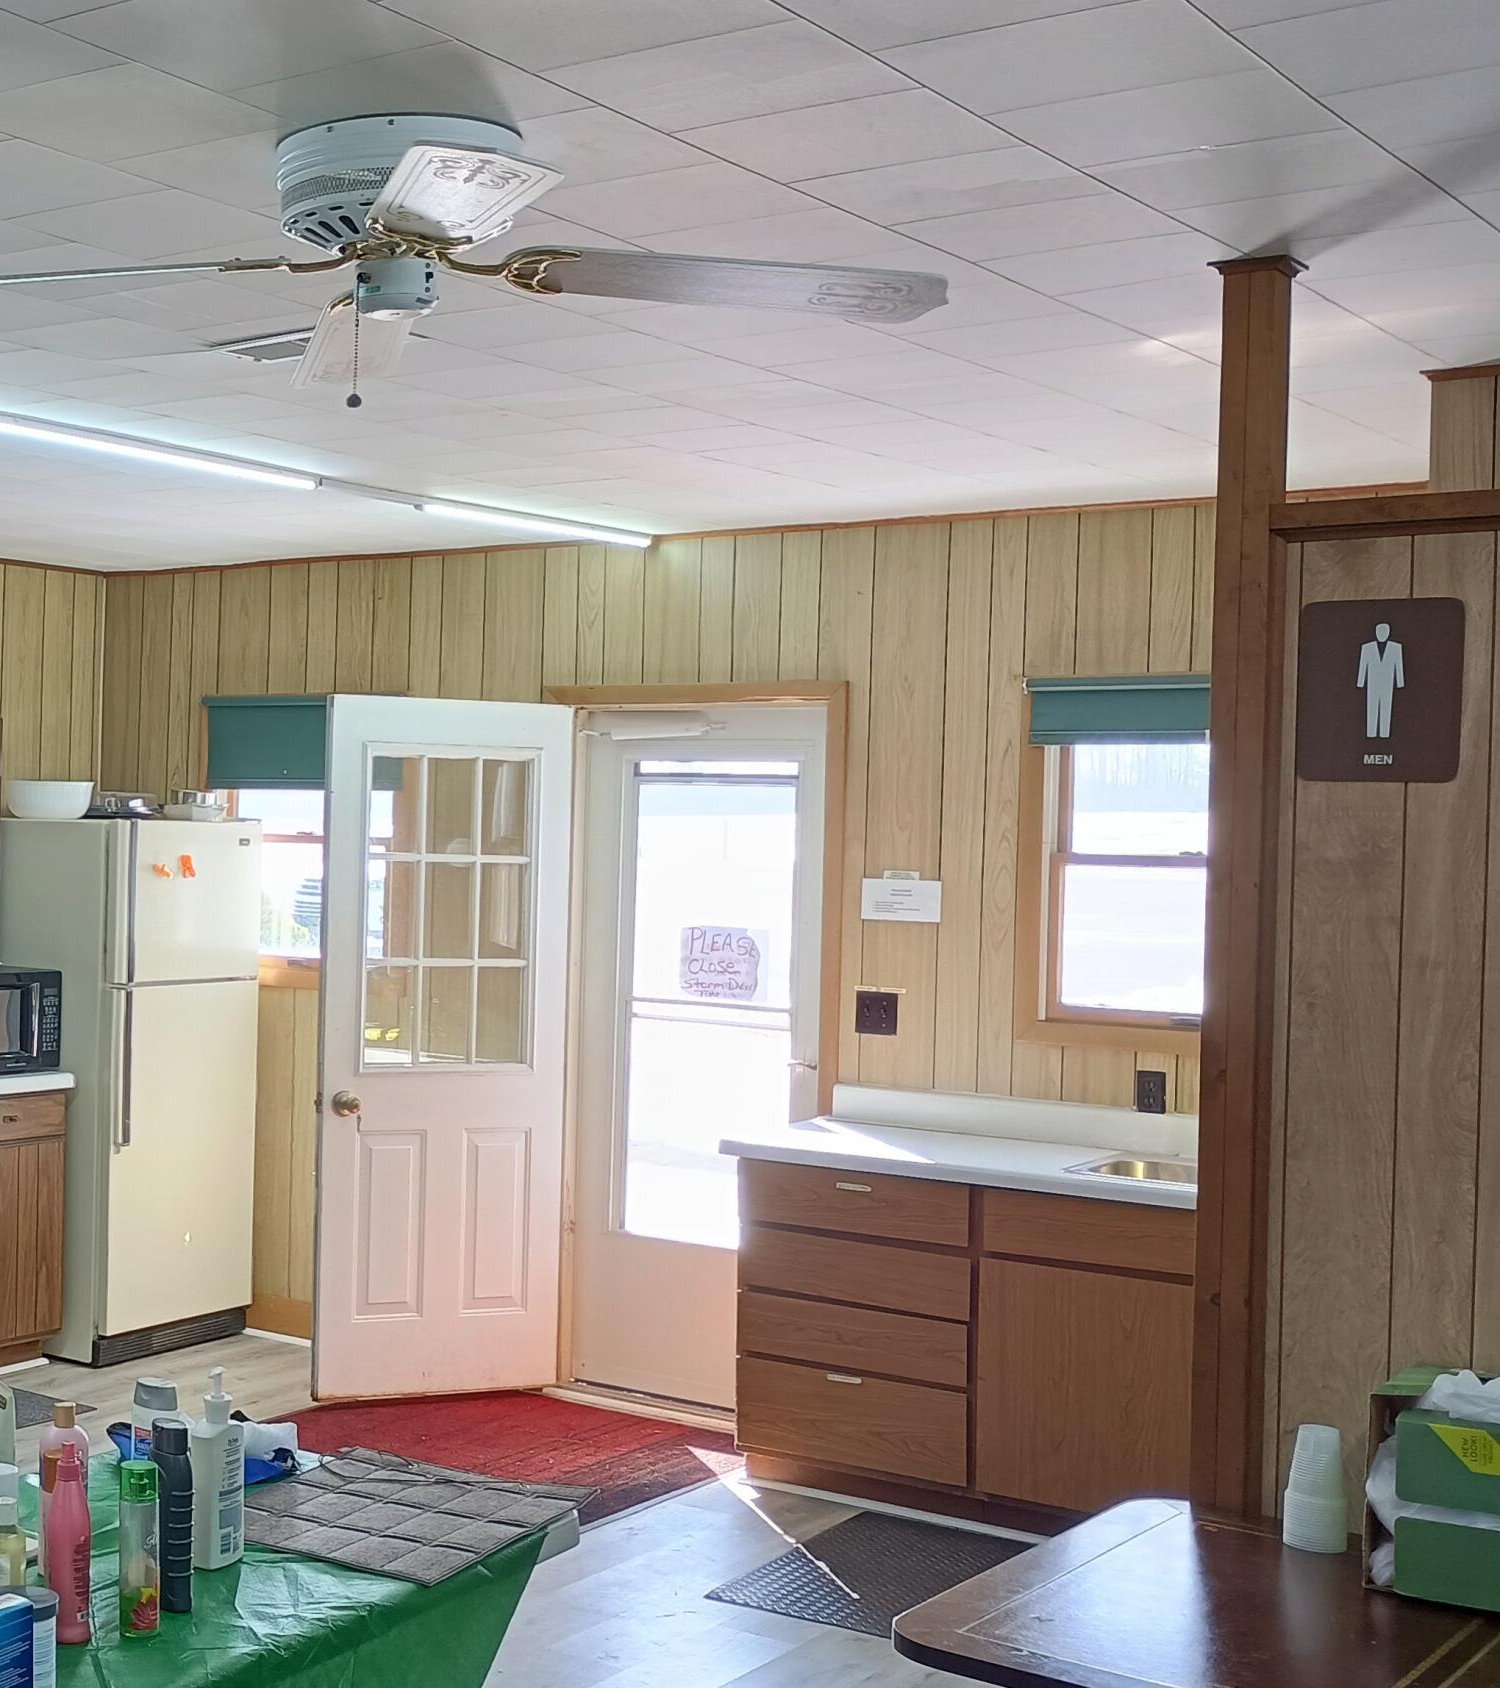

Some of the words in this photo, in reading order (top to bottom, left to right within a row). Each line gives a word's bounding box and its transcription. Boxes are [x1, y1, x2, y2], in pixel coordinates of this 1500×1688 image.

[1363, 754, 1393, 765] MEN
[688, 926, 757, 959] PLEASE
[1461, 1437, 1470, 1458] NEW
